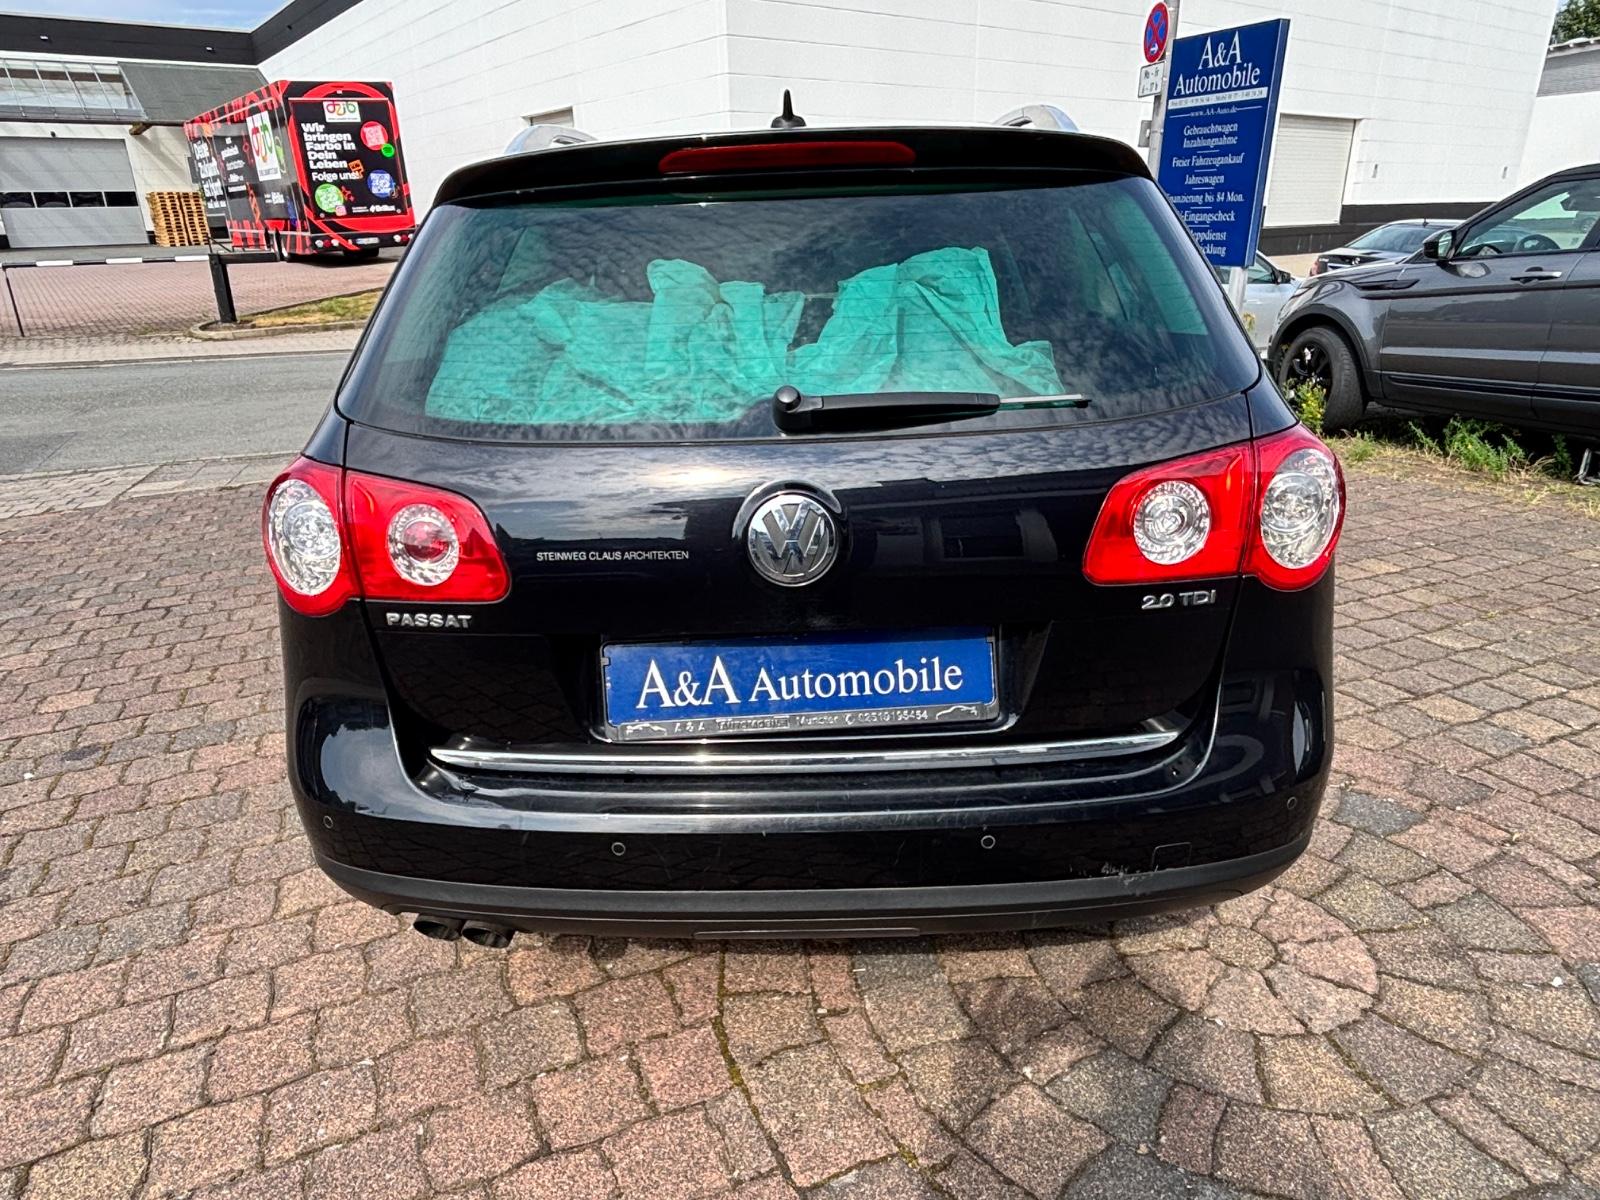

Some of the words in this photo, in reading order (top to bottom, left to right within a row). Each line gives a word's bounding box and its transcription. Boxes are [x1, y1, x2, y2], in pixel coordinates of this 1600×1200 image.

[1198, 31, 1242, 70] A&A
[1173, 63, 1260, 96] Automobile
[301, 122, 326, 132] Wir
[1183, 122, 1238, 136] Gebrauchtwagen
[303, 132, 352, 143] bringen
[1183, 134, 1238, 148] Inzahlungnahme
[306, 142, 342, 151] Farbe
[343, 141, 356, 151] in
[307, 151, 338, 160] Dein
[1172, 157, 1190, 168] Freier
[1191, 153, 1245, 167] Fahrzeugankauf
[309, 159, 348, 170] Leben
[312, 172, 338, 182] Folge
[1184, 174, 1225, 186] Jahreswagen
[1204, 192, 1215, 202] bis
[1226, 191, 1245, 202] Mon.
[536, 551, 587, 562] STEINWEG
[588, 550, 622, 561] CLAUS
[623, 550, 690, 561] ARCHITEKTEN
[1178, 590, 1217, 607] TDI
[385, 612, 473, 630] PASSAT
[636, 655, 740, 709] A&A
[748, 657, 963, 703] Automobile
